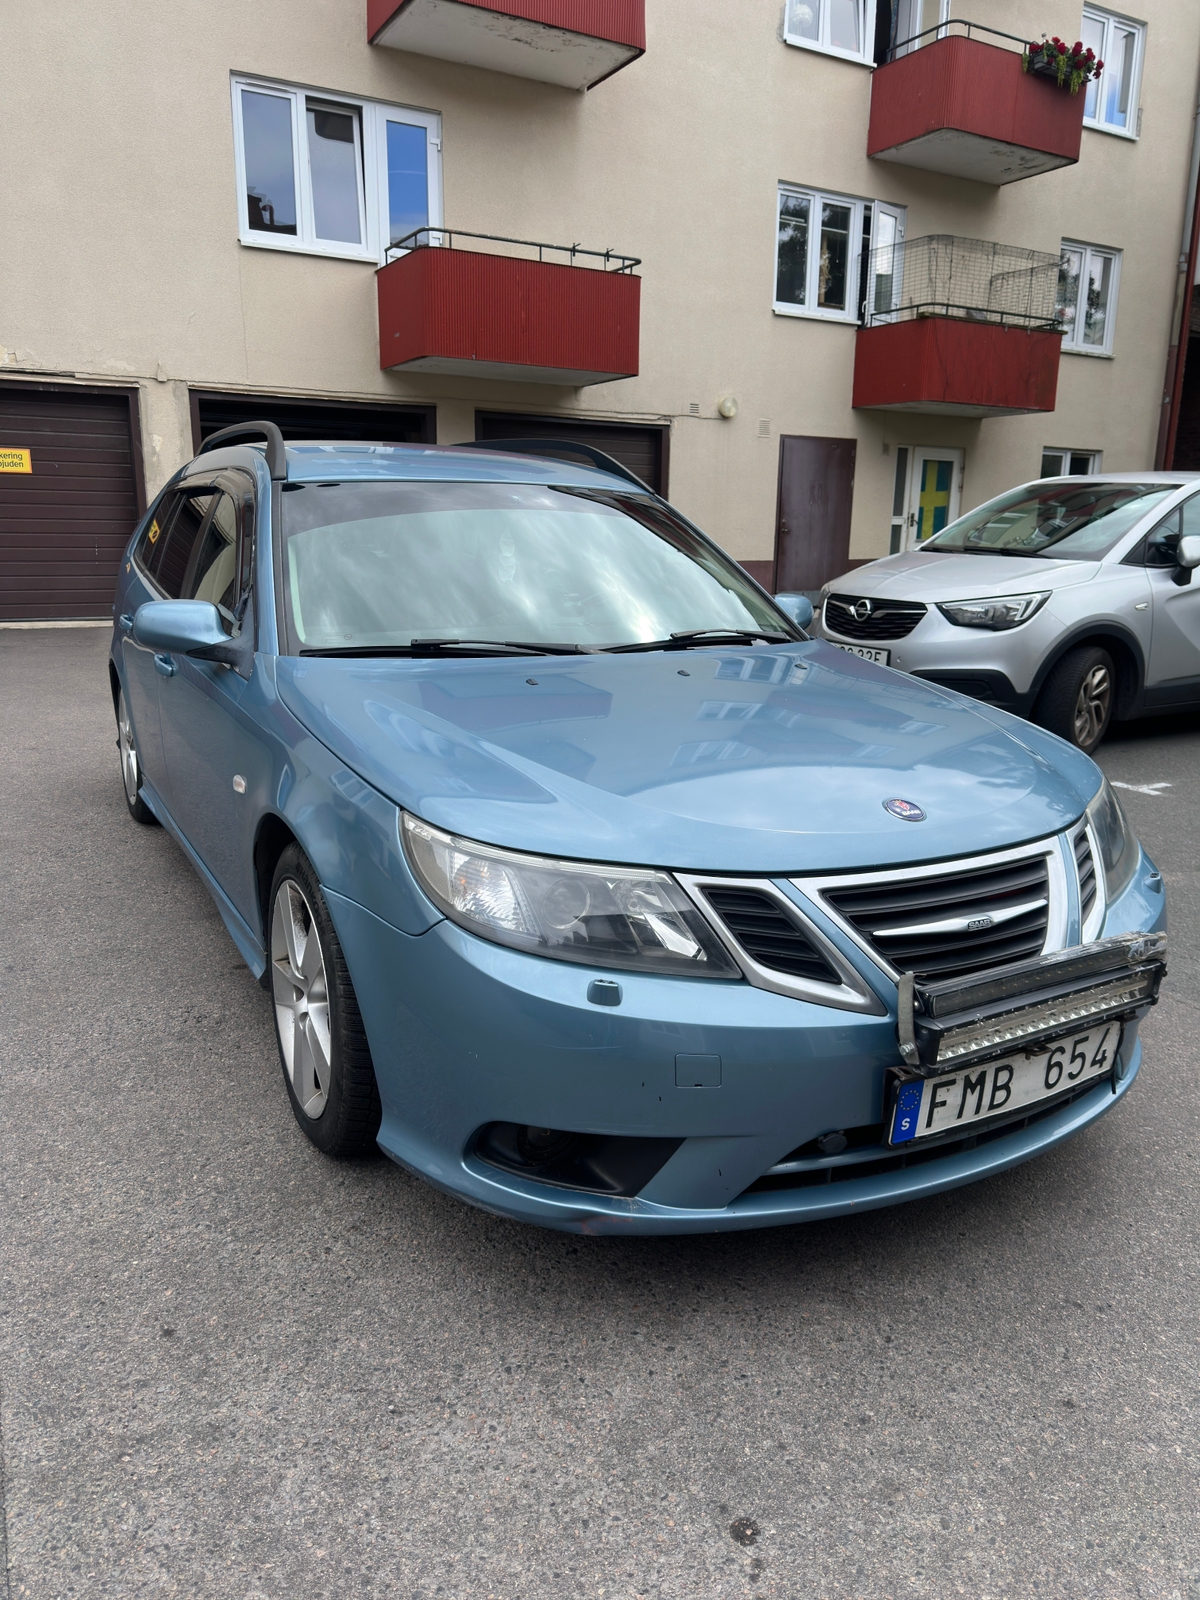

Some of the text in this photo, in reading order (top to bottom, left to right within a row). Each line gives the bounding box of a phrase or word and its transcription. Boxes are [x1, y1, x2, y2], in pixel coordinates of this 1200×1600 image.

[969, 919, 992, 929] SAAB
[925, 1027, 1110, 1129] FMB 654
[901, 1117, 911, 1131] S
